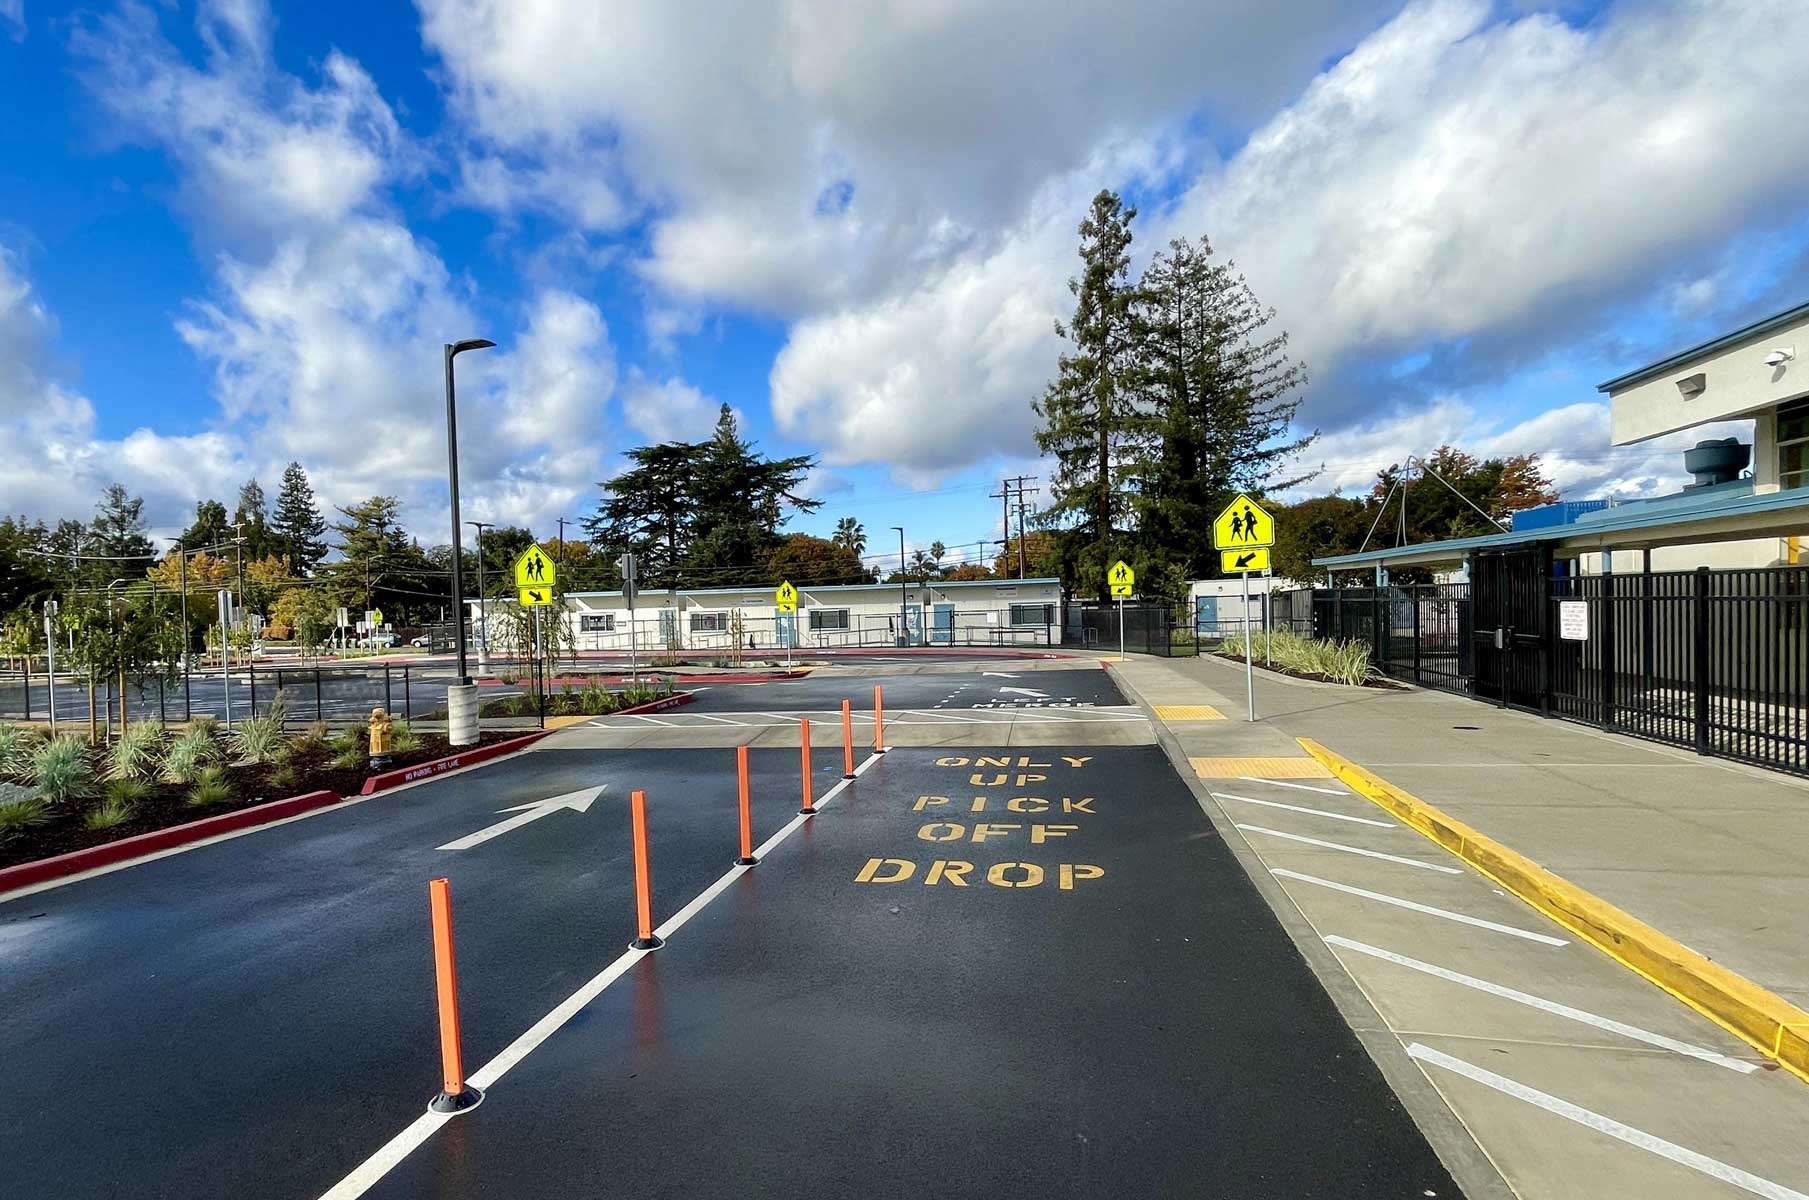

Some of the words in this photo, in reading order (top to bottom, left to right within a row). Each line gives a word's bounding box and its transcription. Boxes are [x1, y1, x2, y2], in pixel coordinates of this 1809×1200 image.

[936, 756, 1096, 768] ONLY
[968, 774, 1048, 786] UP
[912, 796, 1097, 814] PICK
[916, 823, 1079, 844] OFF
[854, 857, 1105, 890] DROP
